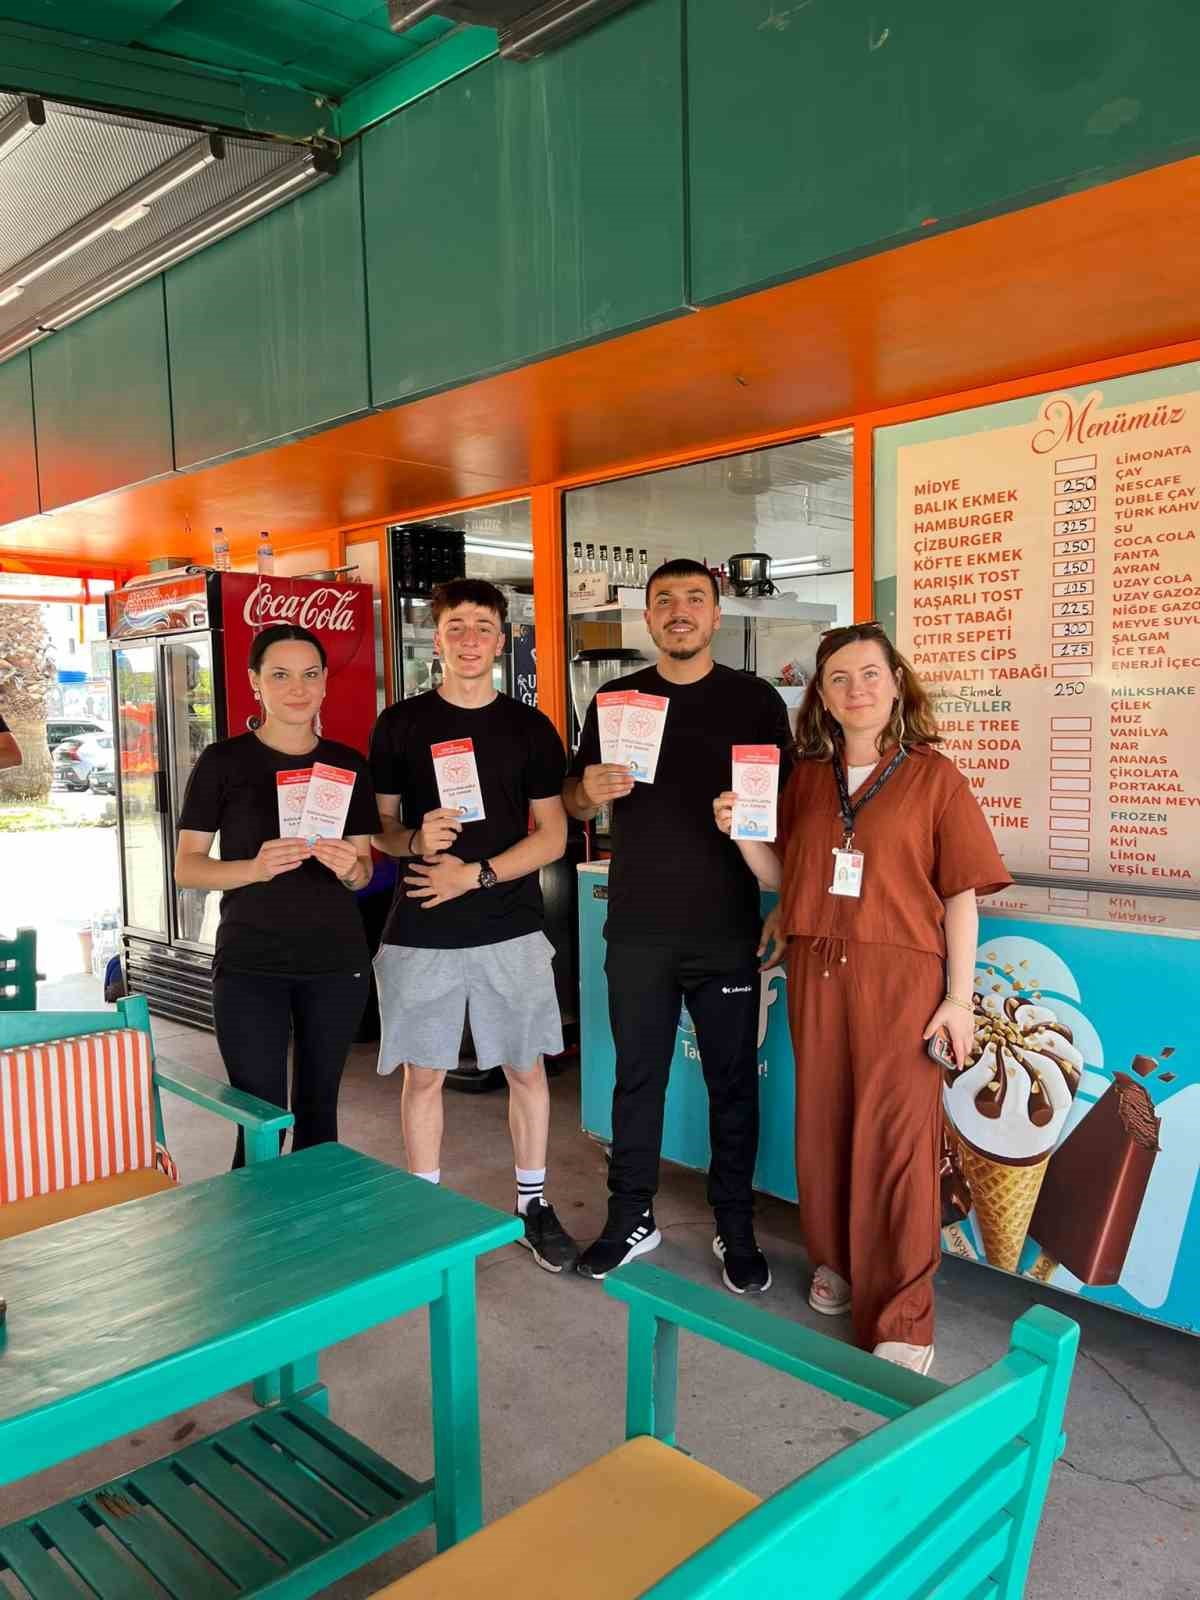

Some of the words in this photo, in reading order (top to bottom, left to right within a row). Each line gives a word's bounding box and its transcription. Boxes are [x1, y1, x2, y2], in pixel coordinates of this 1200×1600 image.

[1031, 398, 1185, 454] Menümüz
[1116, 445, 1192, 465] LİMONATA
[1115, 467, 1143, 480] ÇAY
[914, 479, 960, 496] MİDYE
[1064, 476, 1096, 492] 250
[1115, 475, 1182, 493] NESCAFE
[1167, 486, 1196, 501] ÇAY
[914, 498, 958, 515] BALIK
[962, 489, 1019, 509] EKMEK
[1065, 498, 1091, 514] 300
[1114, 506, 1154, 520] TÜRK
[914, 510, 1014, 534] HAMBURGER
[1062, 520, 1087, 534] 325
[1114, 523, 1134, 534] SU
[913, 531, 1002, 556] ÇİZBURGER
[1114, 537, 1152, 549] COCA
[1156, 530, 1196, 543] COLA
[1062, 540, 1089, 553] 250
[914, 556, 962, 572] KÖFTE
[967, 549, 1023, 566] EKMEK
[1114, 549, 1160, 562] FANTA
[1064, 561, 1088, 575] 150
[1113, 562, 1160, 575] AYRAN
[914, 574, 974, 590] KARIŞIK
[979, 569, 1020, 583] TOST
[1113, 578, 1150, 590] UZAY
[1153, 574, 1193, 586] COLA
[913, 592, 977, 610] KAŞARLI
[981, 588, 1023, 602] TOST
[1113, 592, 1150, 603] UZAY
[1061, 603, 1089, 616] 225
[913, 613, 952, 627] TOST
[957, 609, 1012, 625] TABAĞI
[1113, 618, 1160, 629] MEYVE
[1064, 623, 1087, 637] 300
[913, 633, 952, 649] ÇITIR
[956, 627, 1012, 645] SEPETİ
[1112, 632, 1169, 645] ŞALGAM
[913, 650, 977, 665] PATATES
[980, 646, 1017, 661] CİPS
[1112, 646, 1134, 657] İCE
[1139, 646, 1166, 656] TEA
[1112, 657, 1162, 669] ENERJİ
[991, 664, 1048, 680] TABAĞI
[1054, 681, 1085, 696] 250
[1111, 686, 1195, 698] MİLKSHAKE
[1111, 701, 1152, 713] ÇİLEK
[979, 719, 1021, 731] TREE
[1111, 715, 1142, 724] MUZ
[1110, 727, 1169, 737] VANİLYA
[977, 739, 1021, 751] SODA
[1110, 742, 1139, 750] NAR
[1110, 755, 1168, 764] ANANAS
[1110, 768, 1179, 780] ÇİKOLATA
[1110, 782, 1184, 792] PORTAKAL
[1109, 796, 1161, 805] ORMAN
[990, 812, 1029, 829] TİME
[1111, 811, 1168, 822] FROZEN
[1110, 825, 1168, 836] ANANAS
[1110, 837, 1137, 847] KİVİ
[1110, 850, 1156, 862] LİMON
[1109, 863, 1147, 876] YEŞİL
[1152, 867, 1192, 879] ELMA
